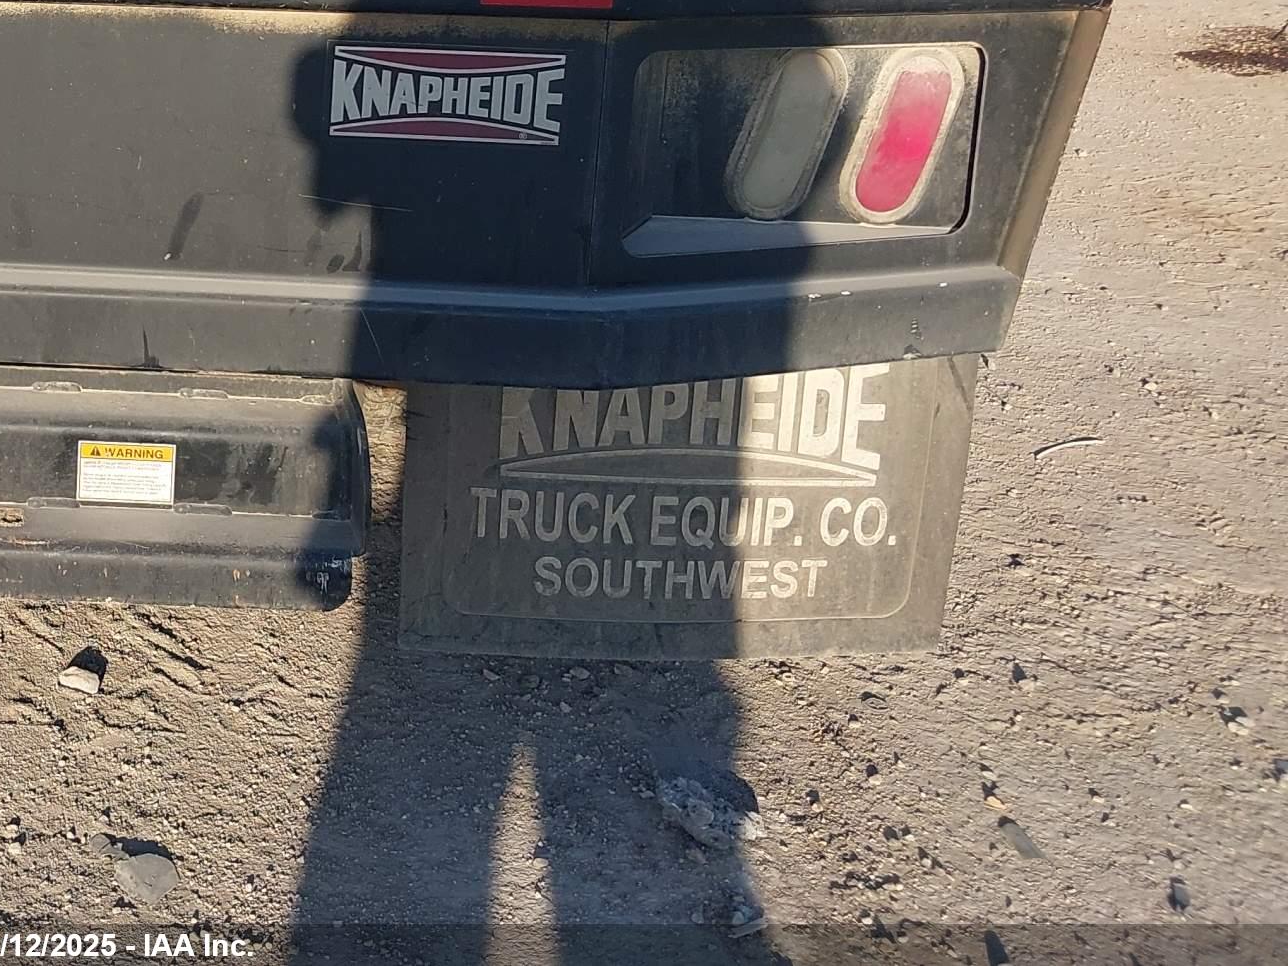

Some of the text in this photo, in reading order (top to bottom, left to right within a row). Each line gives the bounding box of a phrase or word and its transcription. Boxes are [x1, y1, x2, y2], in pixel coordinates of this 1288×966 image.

[330, 59, 565, 132] KNAPHEIDE
[499, 362, 891, 472] KNAPHEIDE
[104, 447, 164, 460] WARNING
[470, 487, 898, 550] TRUCK EQUIP. CO.
[534, 556, 828, 600] SOUTHWEST
